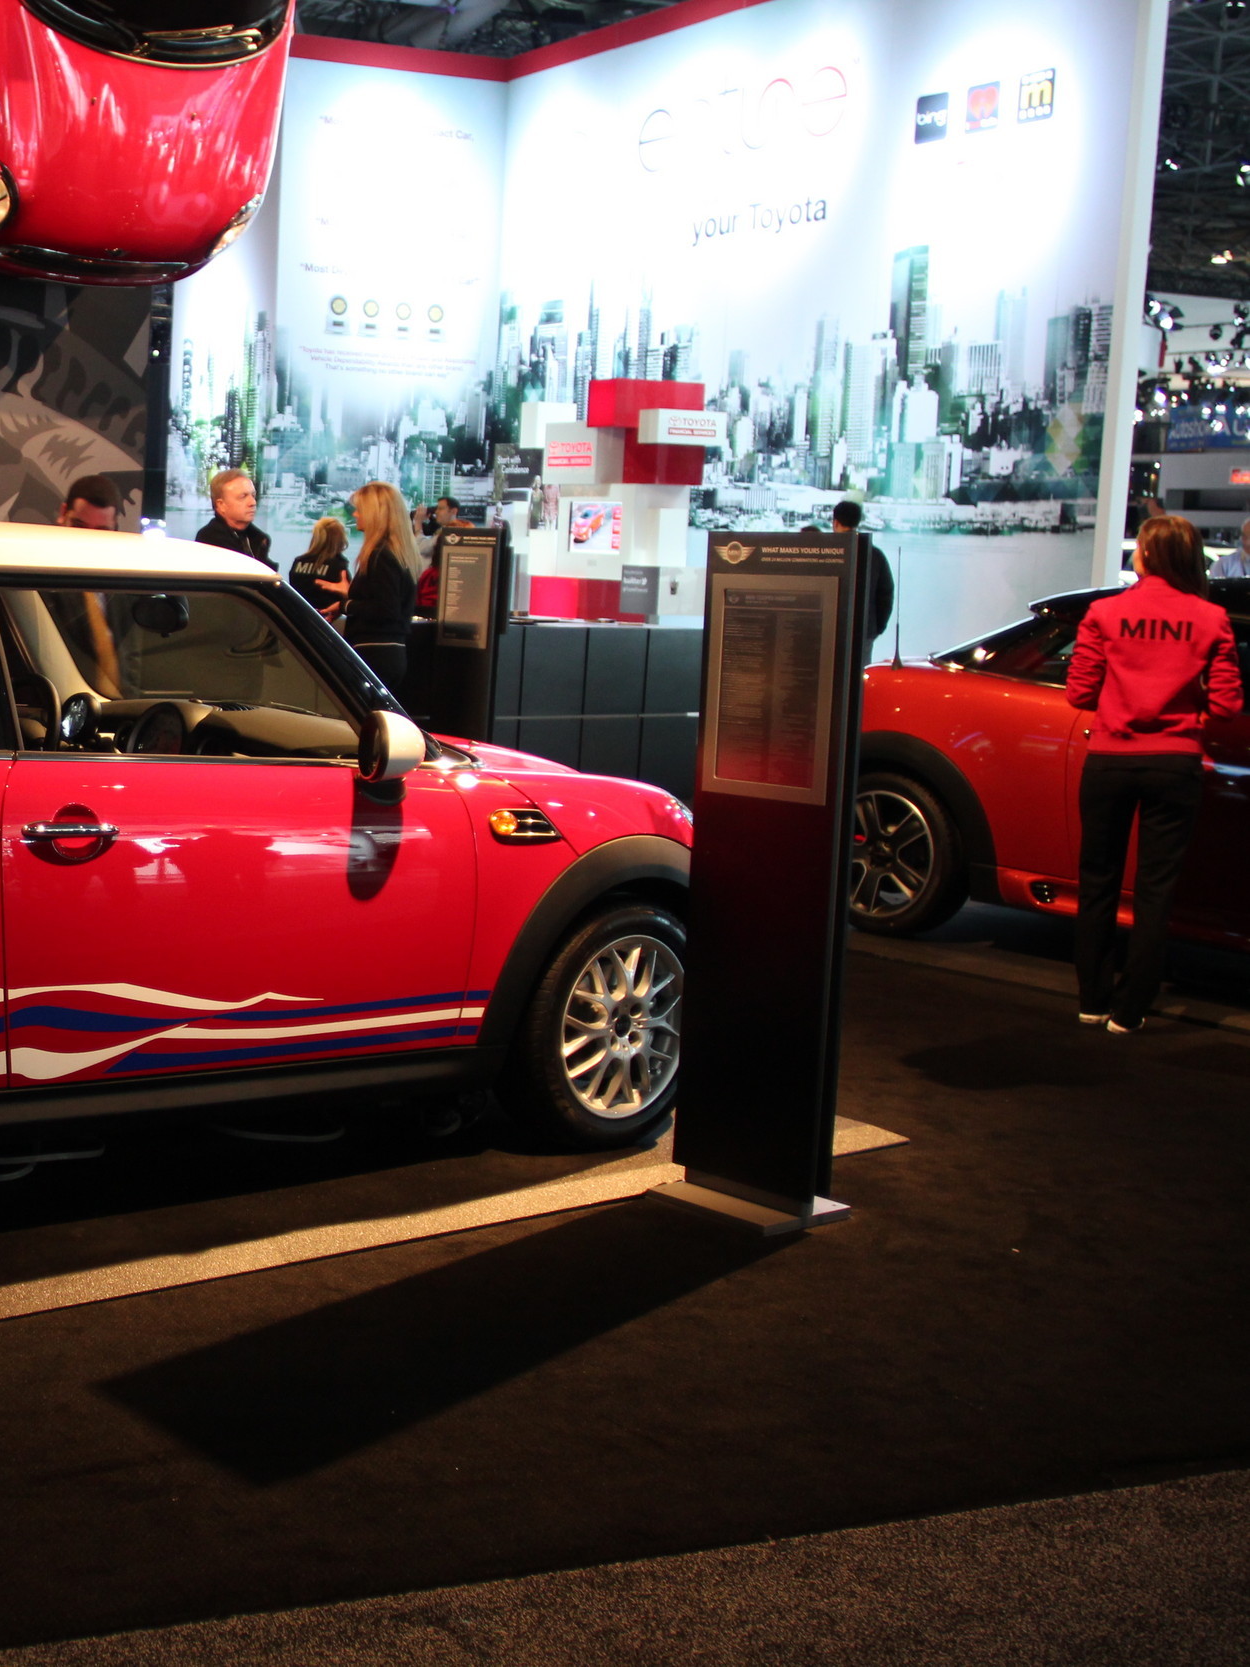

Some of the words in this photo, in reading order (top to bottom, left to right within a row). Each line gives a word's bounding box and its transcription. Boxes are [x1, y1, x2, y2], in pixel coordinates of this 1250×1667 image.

[692, 213, 739, 248] your
[749, 196, 829, 234] Toyota
[683, 417, 717, 427] TOYOTA
[560, 441, 593, 454] TOYOTA
[761, 546, 779, 554] WHAT
[779, 547, 800, 555] MAKES
[800, 547, 820, 555] YOURS
[821, 547, 845, 556] UNIQUE
[1119, 618, 1194, 641] MINI
